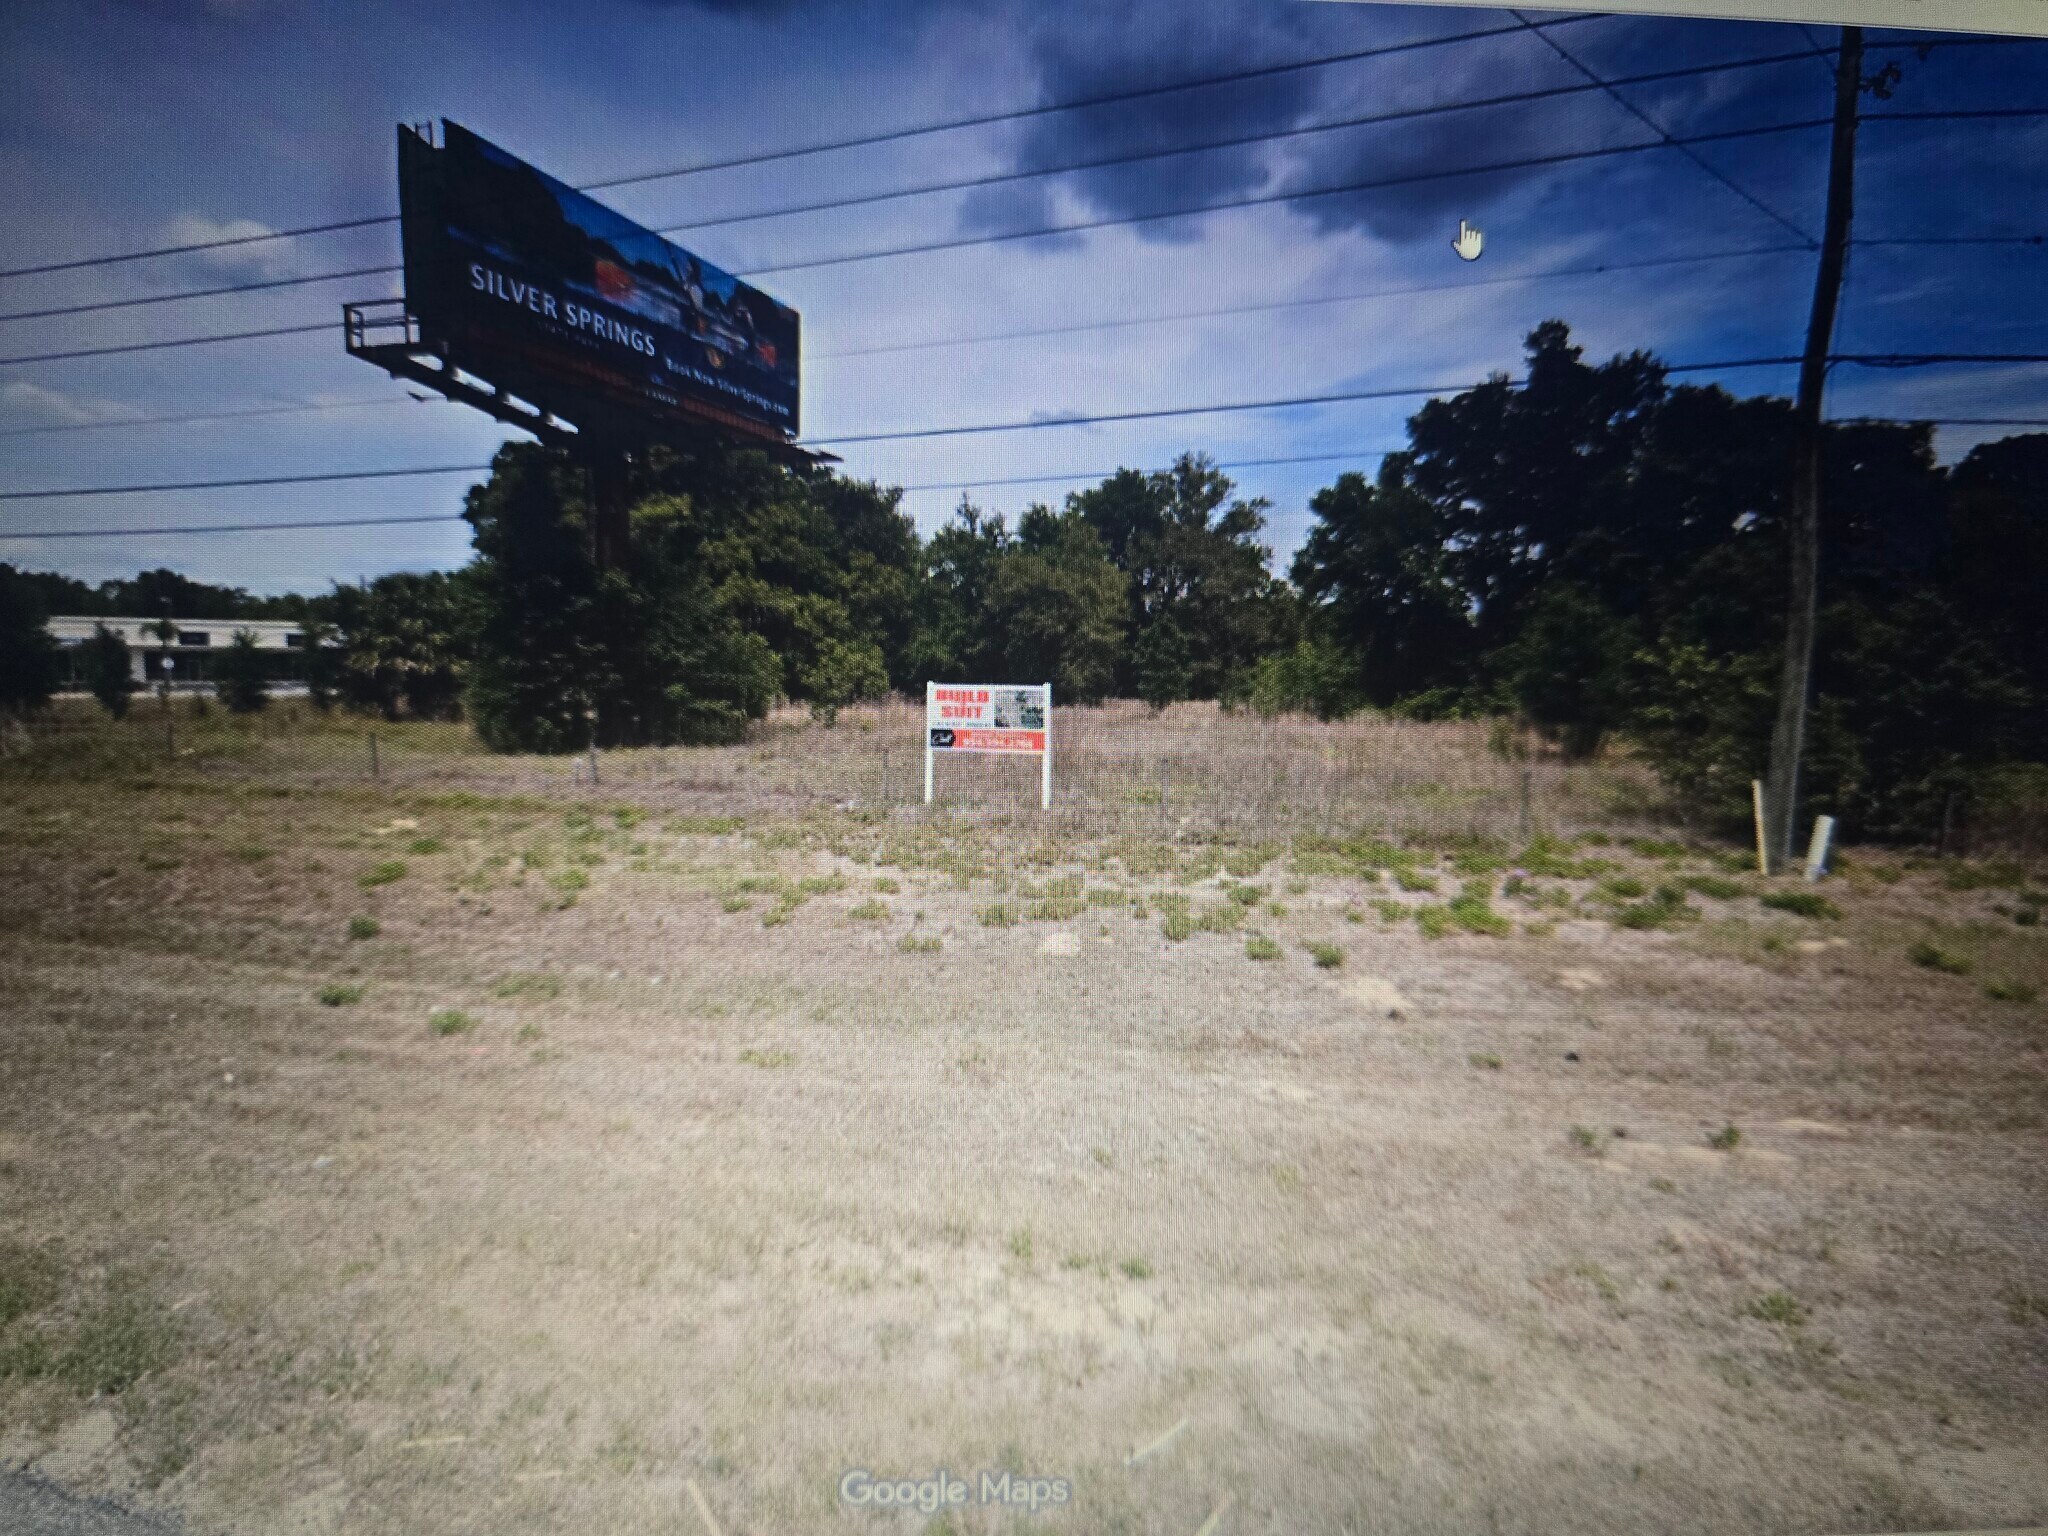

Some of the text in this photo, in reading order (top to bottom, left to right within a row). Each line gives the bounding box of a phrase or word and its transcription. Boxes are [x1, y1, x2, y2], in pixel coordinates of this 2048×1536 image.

[470, 264, 558, 320] SILVER
[566, 303, 656, 357] SPRINGS
[936, 689, 989, 703] BUILD
[941, 705, 982, 718] SUIT
